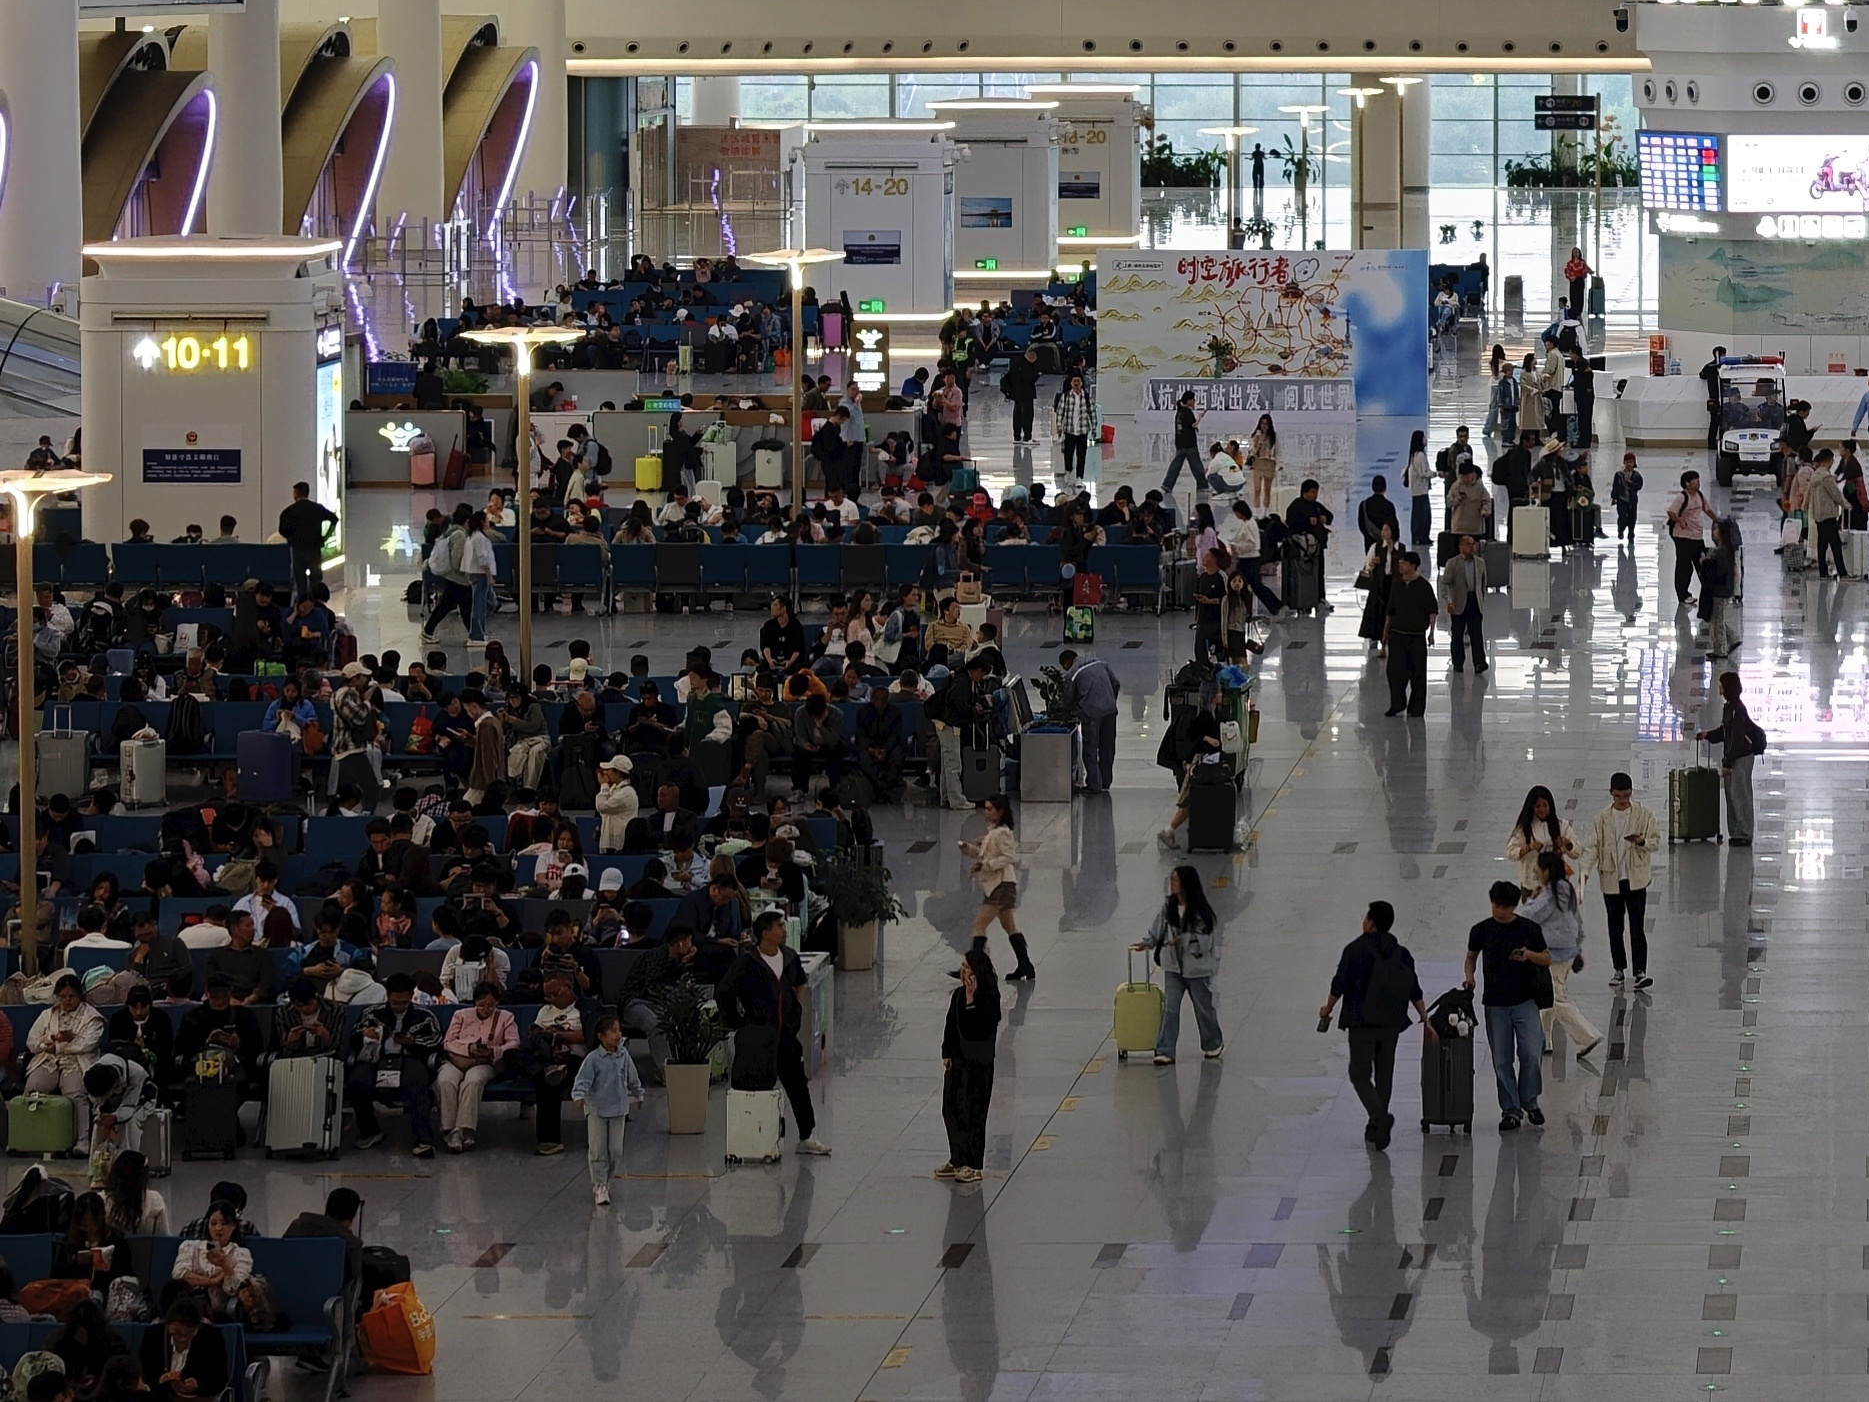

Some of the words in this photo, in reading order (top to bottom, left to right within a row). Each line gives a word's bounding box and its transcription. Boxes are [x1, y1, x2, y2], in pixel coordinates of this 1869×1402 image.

[852, 178, 909, 196] 14-20
[1177, 255, 1290, 288] 时空旅行者
